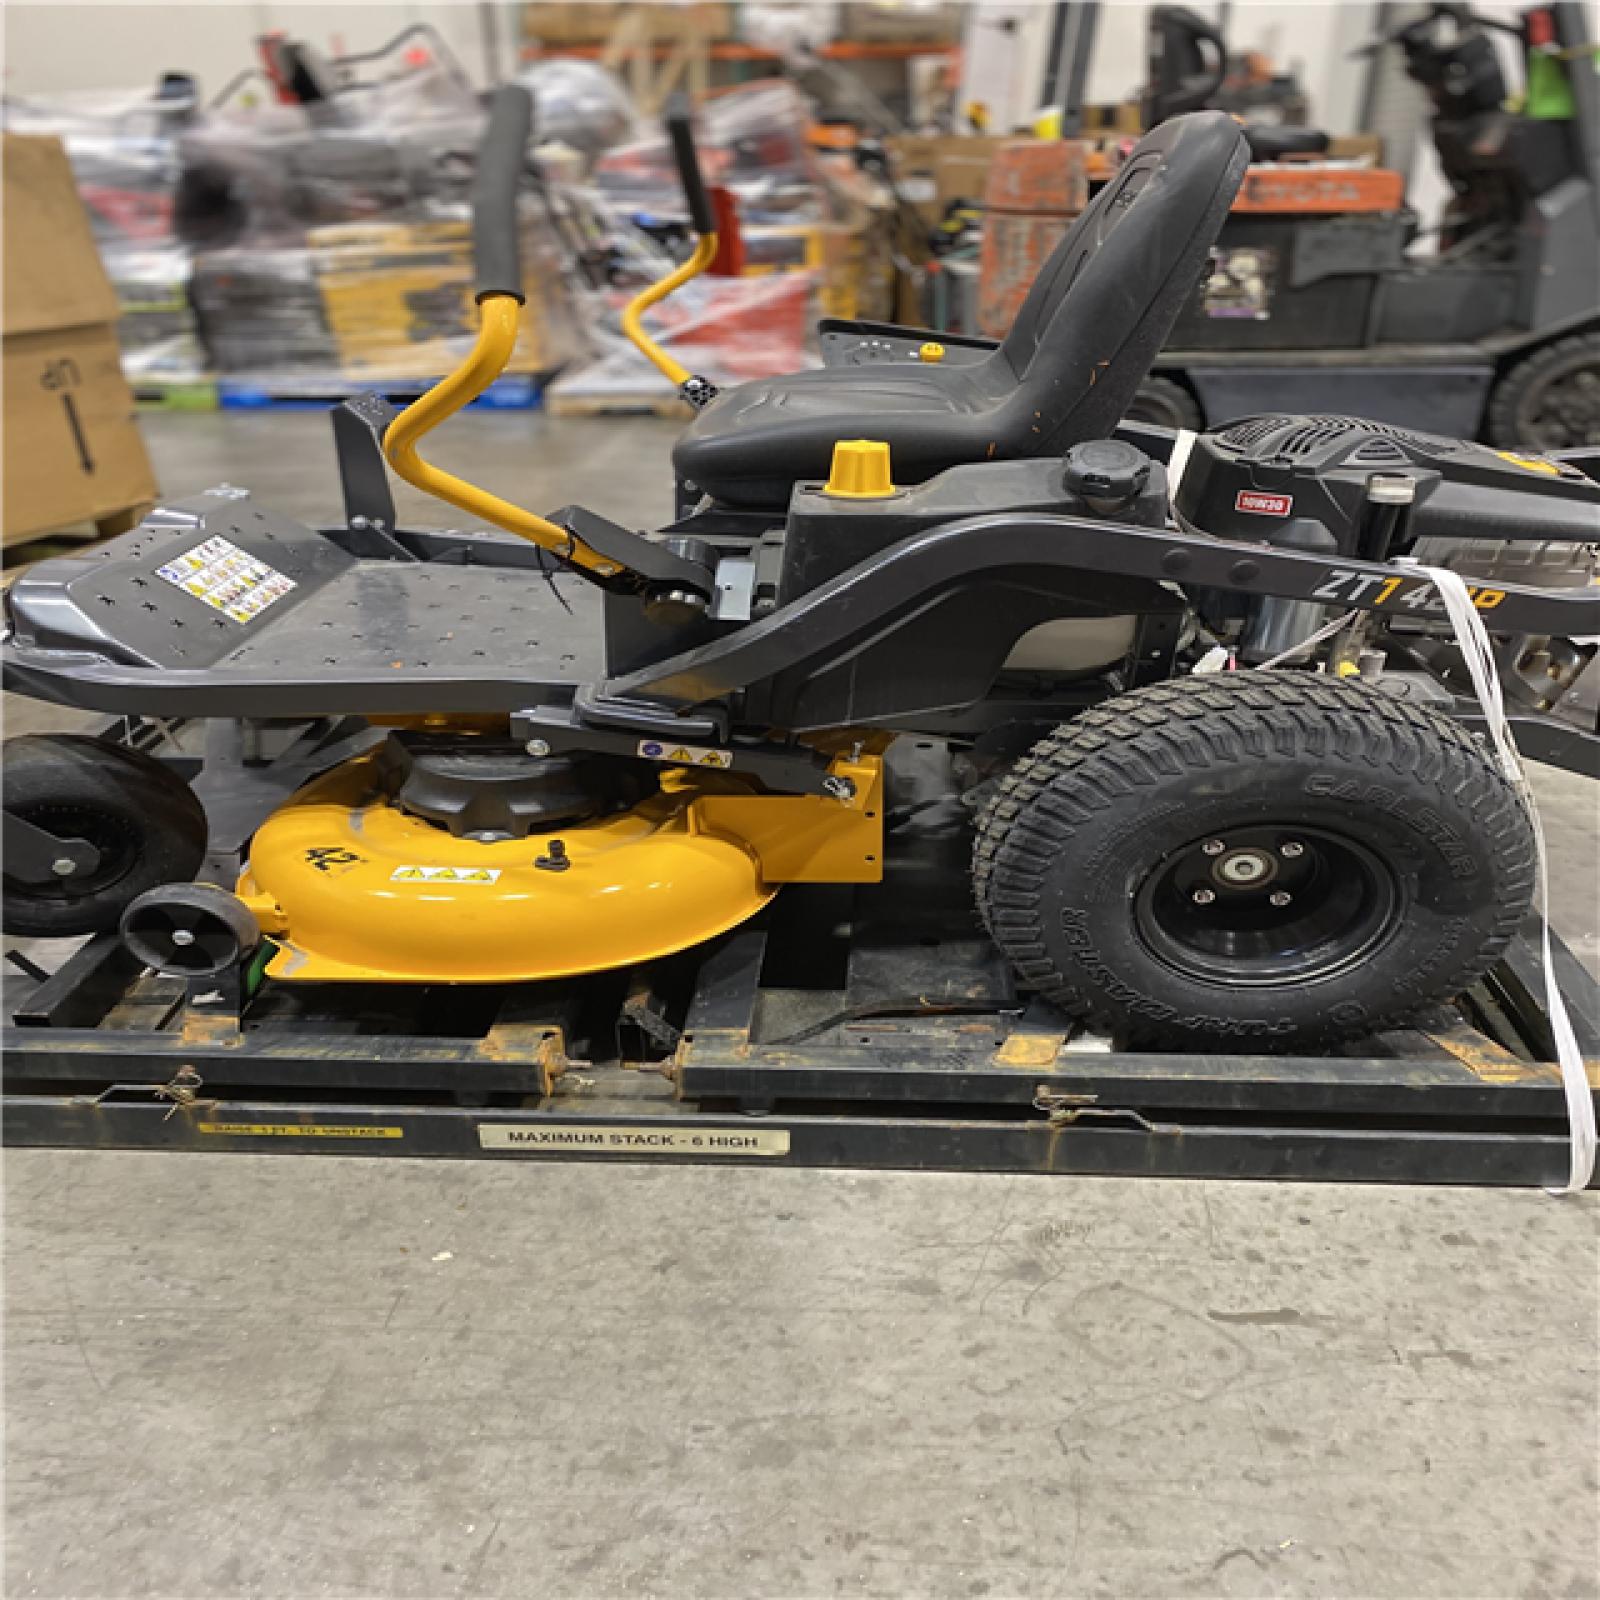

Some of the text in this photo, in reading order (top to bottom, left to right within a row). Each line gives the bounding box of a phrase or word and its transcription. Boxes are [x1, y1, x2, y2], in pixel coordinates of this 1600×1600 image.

[1311, 569, 1403, 605] ZT1
[507, 1131, 604, 1144] MAXIMUM
[609, 1133, 675, 1146] STACK
[691, 1136, 704, 1146] 6
[709, 1136, 759, 1148] HIGH
